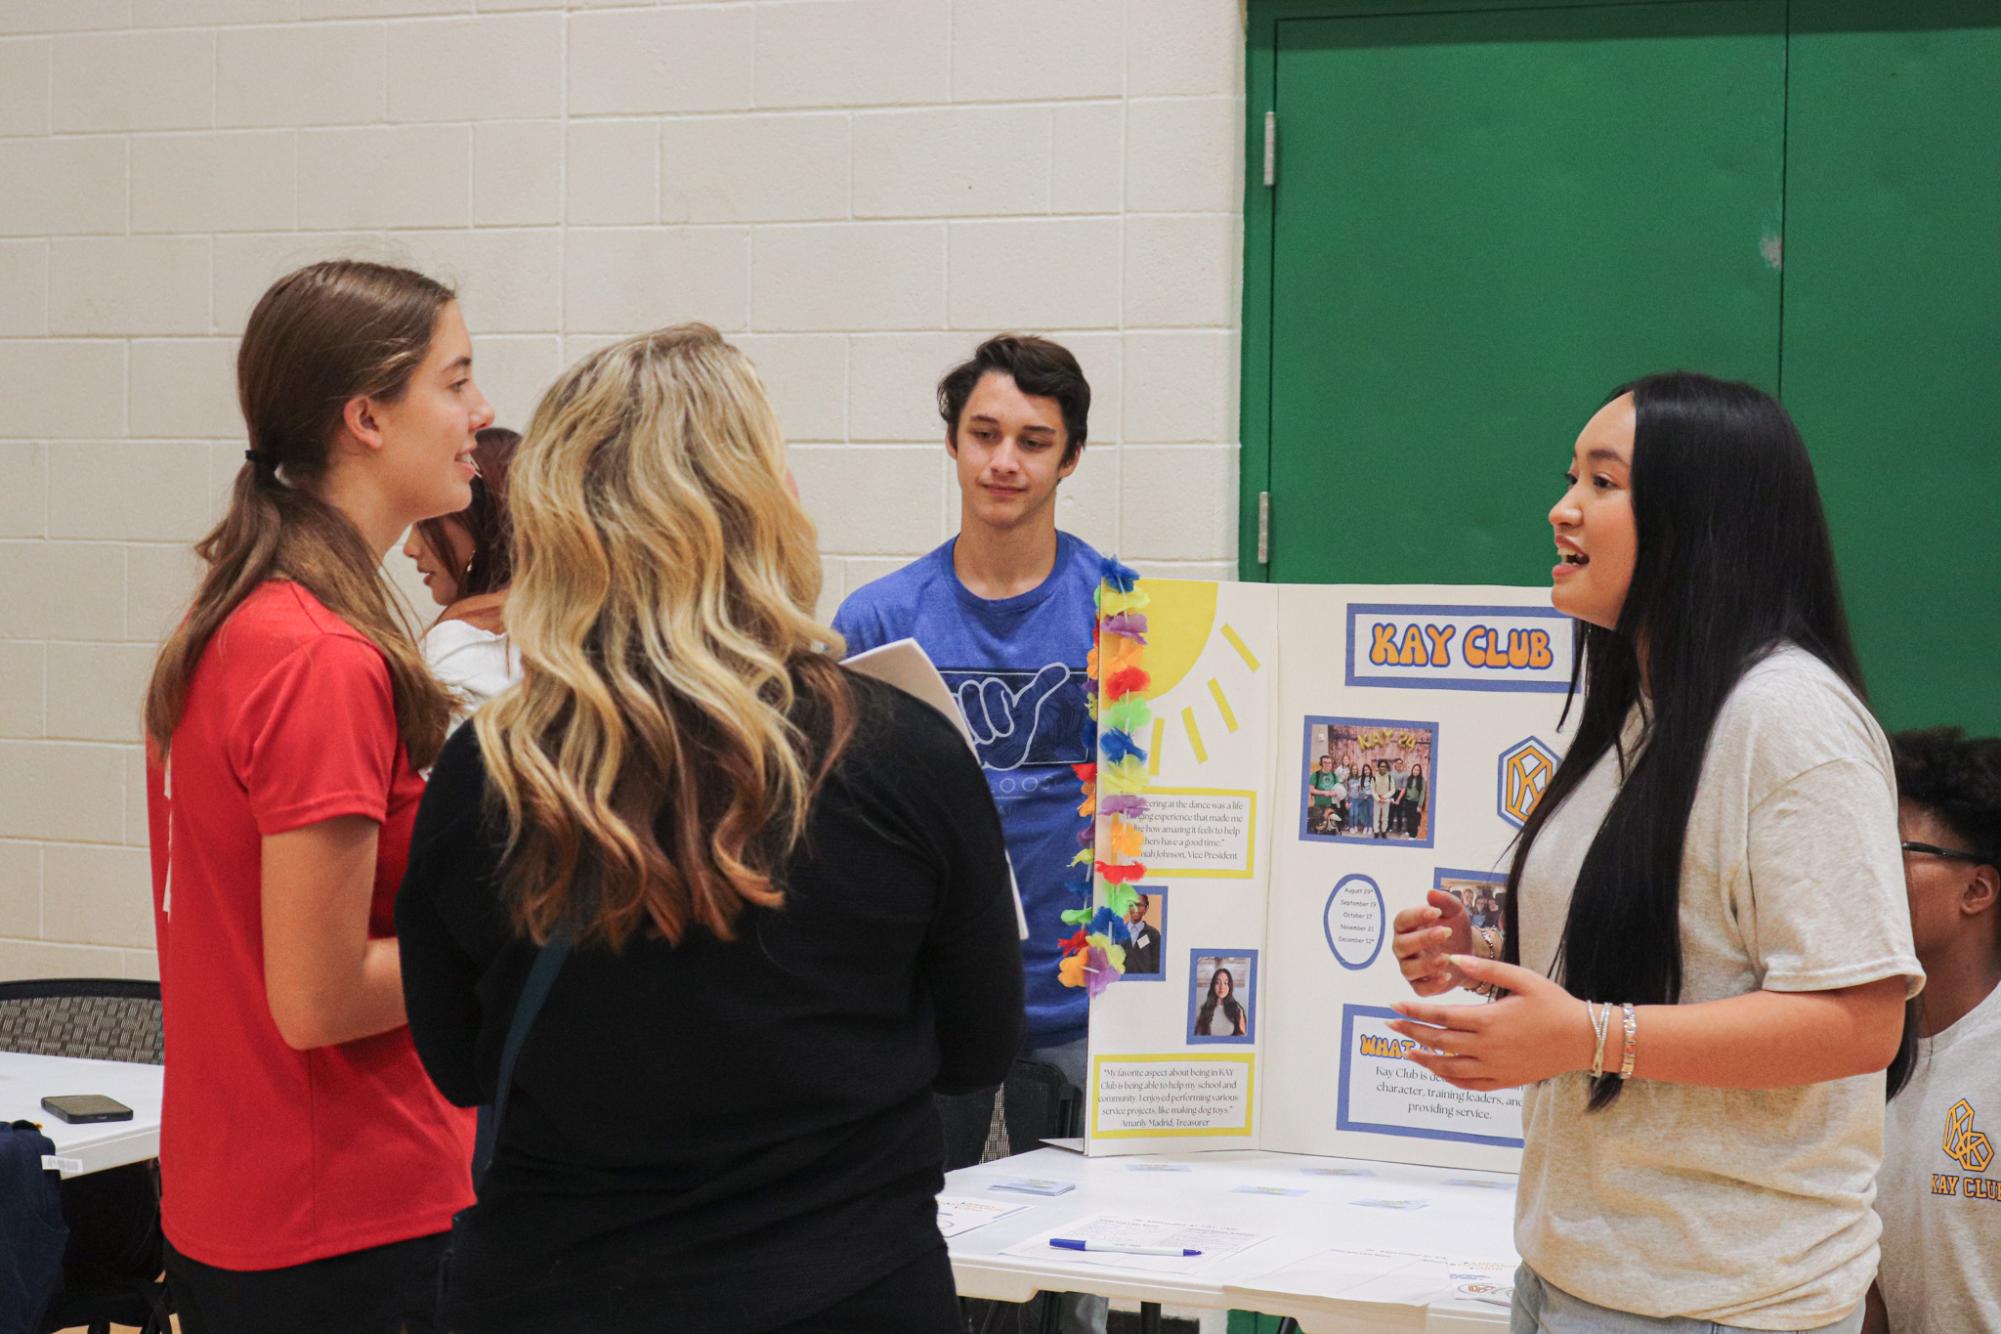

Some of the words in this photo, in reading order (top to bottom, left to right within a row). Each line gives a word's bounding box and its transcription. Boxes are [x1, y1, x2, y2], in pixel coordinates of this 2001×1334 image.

[1369, 622, 1456, 667] KAY
[1462, 624, 1554, 670] CLUB
[1376, 1065, 1394, 1079] Kay
[1395, 1067, 1419, 1079] Club
[1420, 1072, 1429, 1081] is
[1376, 1081, 1426, 1098] character,
[1427, 1088, 1466, 1104] training
[1466, 1090, 1504, 1106] leaders,
[1407, 1101, 1454, 1118] providing
[1455, 1106, 1493, 1120] service.
[1931, 1173, 1960, 1196] KAY
